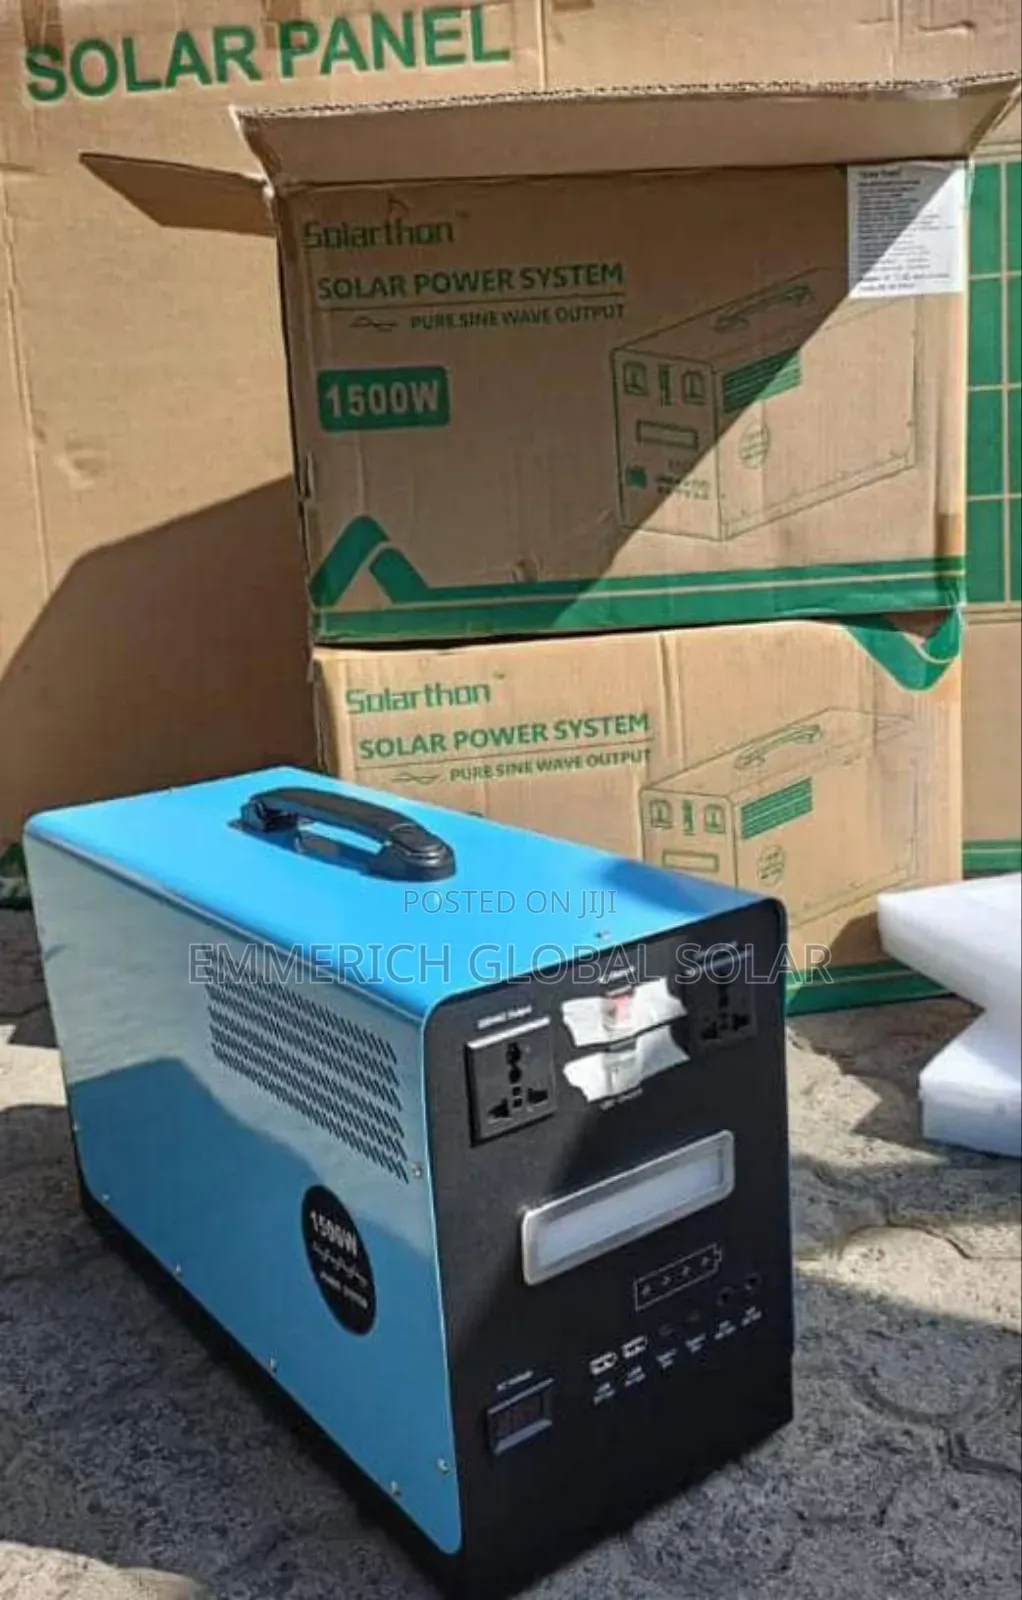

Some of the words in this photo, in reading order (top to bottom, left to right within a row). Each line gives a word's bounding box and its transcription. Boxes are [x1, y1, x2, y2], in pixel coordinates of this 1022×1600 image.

[26, 25, 262, 101] SOLAR
[279, 4, 511, 79] PANEL
[302, 216, 455, 249] Solarthon
[317, 274, 406, 300] SOLAR
[414, 266, 515, 294] POWER
[520, 262, 624, 290] SYSTEM
[410, 313, 457, 330] PURE
[459, 310, 499, 330] SINE
[501, 307, 549, 326] WAVE
[554, 304, 625, 322] OUTPUT
[326, 380, 439, 418] 1500W
[345, 682, 491, 714] Solarthon
[358, 733, 447, 760] SOLAR
[453, 722, 549, 751] POWER
[554, 712, 649, 741] SYSTEM
[450, 766, 492, 782] PURE
[495, 760, 534, 777] SINE
[536, 755, 582, 773] WAVE
[586, 749, 652, 768] OUTPUT
